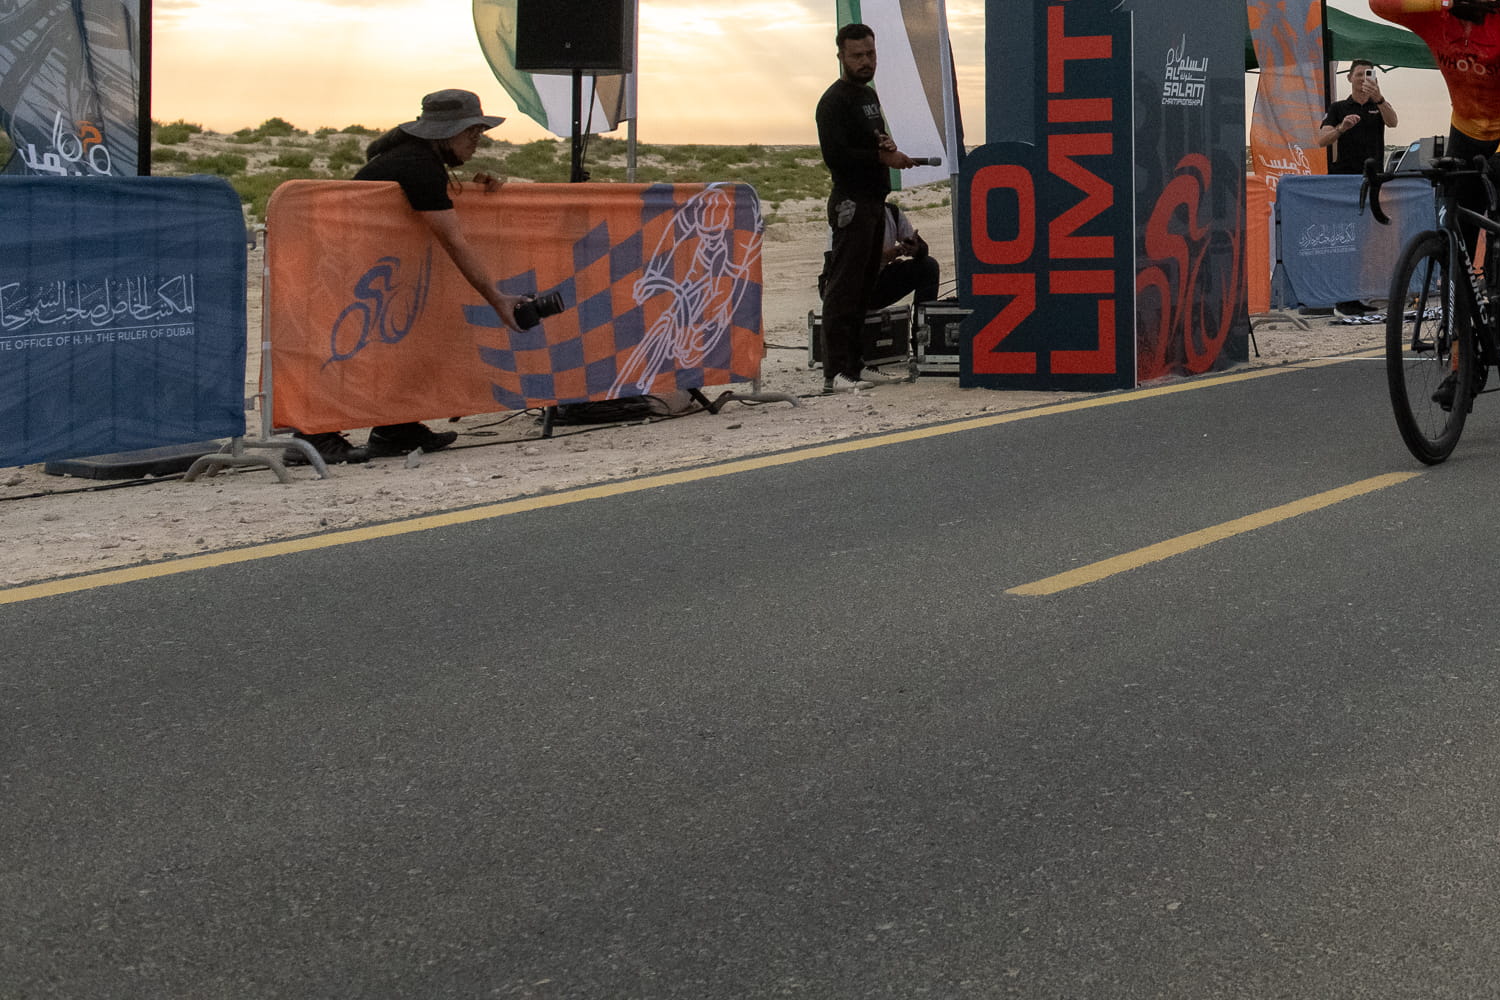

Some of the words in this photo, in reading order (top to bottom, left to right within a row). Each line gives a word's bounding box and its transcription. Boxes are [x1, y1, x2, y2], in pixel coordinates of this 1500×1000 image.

[1165, 67, 1179, 80] AL
[1163, 82, 1205, 106] SALAM
[970, 164, 1037, 375] NO
[15, 336, 52, 349] OFFICE
[56, 335, 71, 346] OF
[73, 335, 83, 344] H.
[85, 334, 93, 343] H.
[97, 333, 115, 342] THE
[118, 330, 148, 341] RULER
[150, 329, 163, 338] OF
[167, 327, 194, 337] DUBAI
